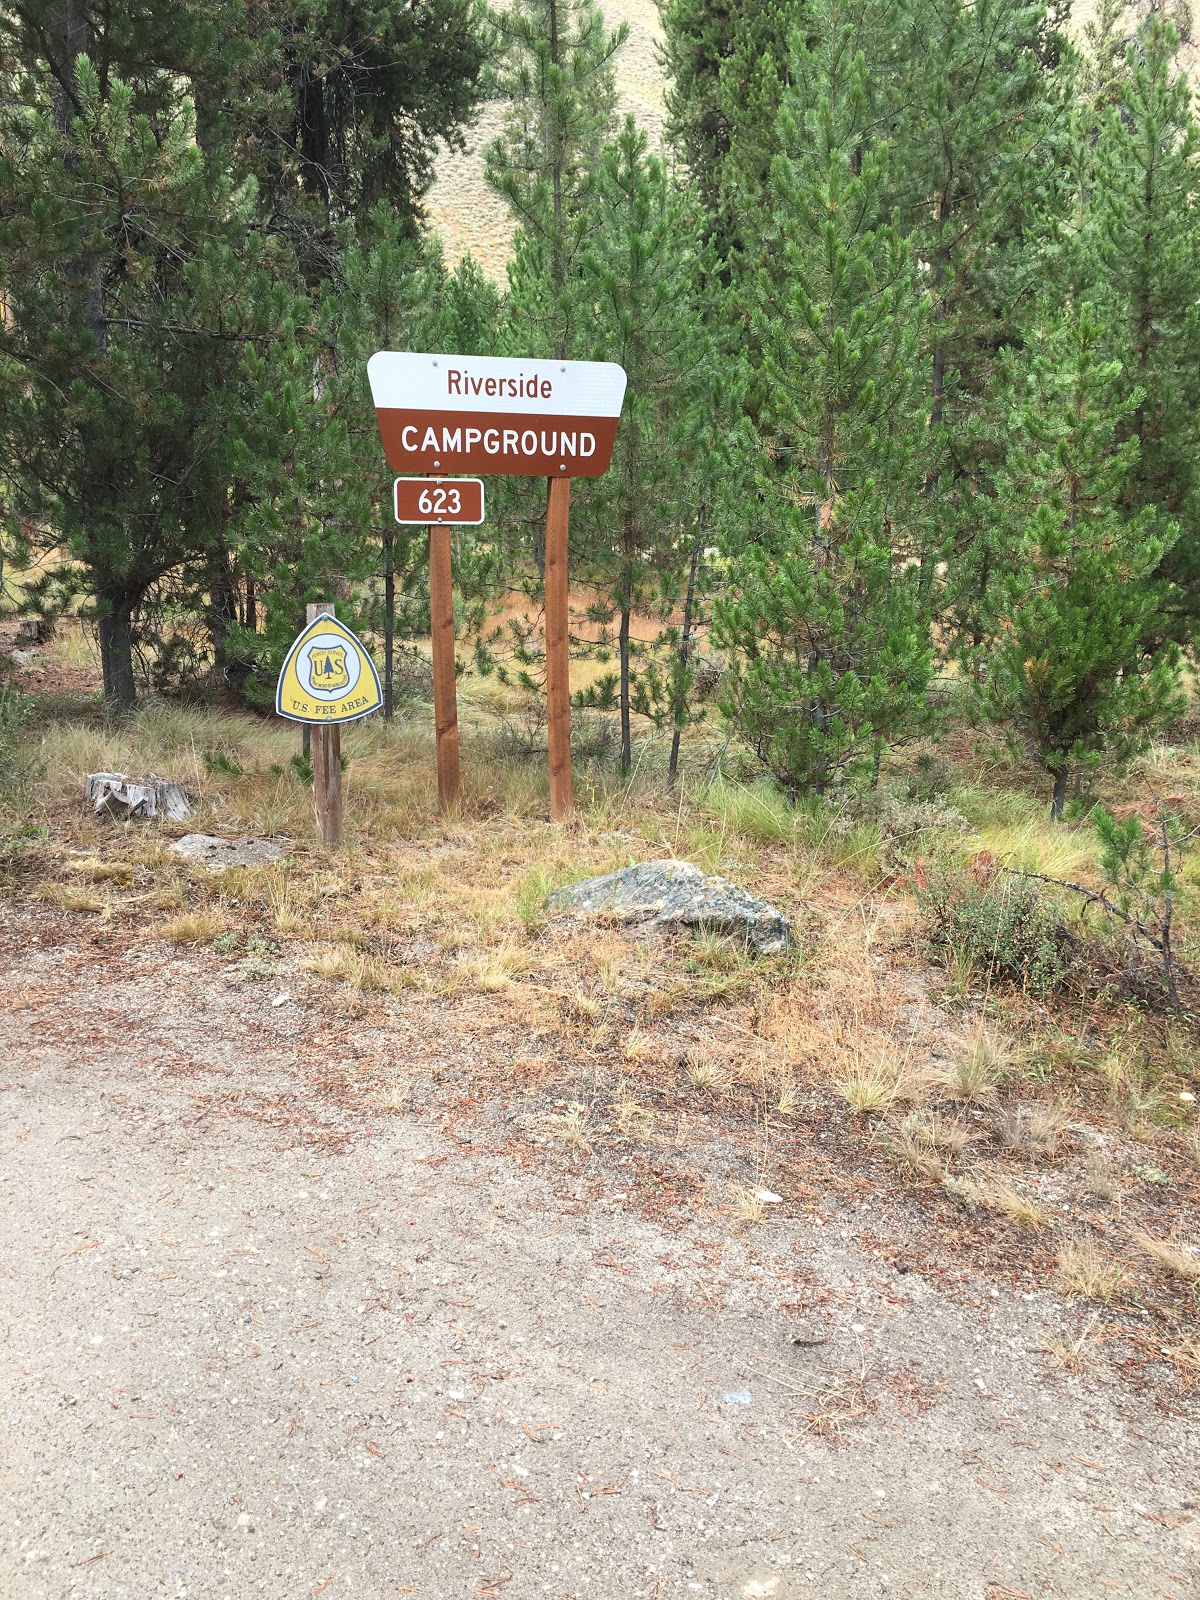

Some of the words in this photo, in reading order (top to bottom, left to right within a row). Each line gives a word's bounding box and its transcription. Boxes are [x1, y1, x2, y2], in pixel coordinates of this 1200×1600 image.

[447, 369, 553, 399] Riverside
[401, 425, 596, 458] CAMPGROUND
[418, 488, 462, 515] 623
[292, 700, 310, 713] U.S.
[315, 705, 336, 715] FEE
[341, 696, 370, 712] AREA
